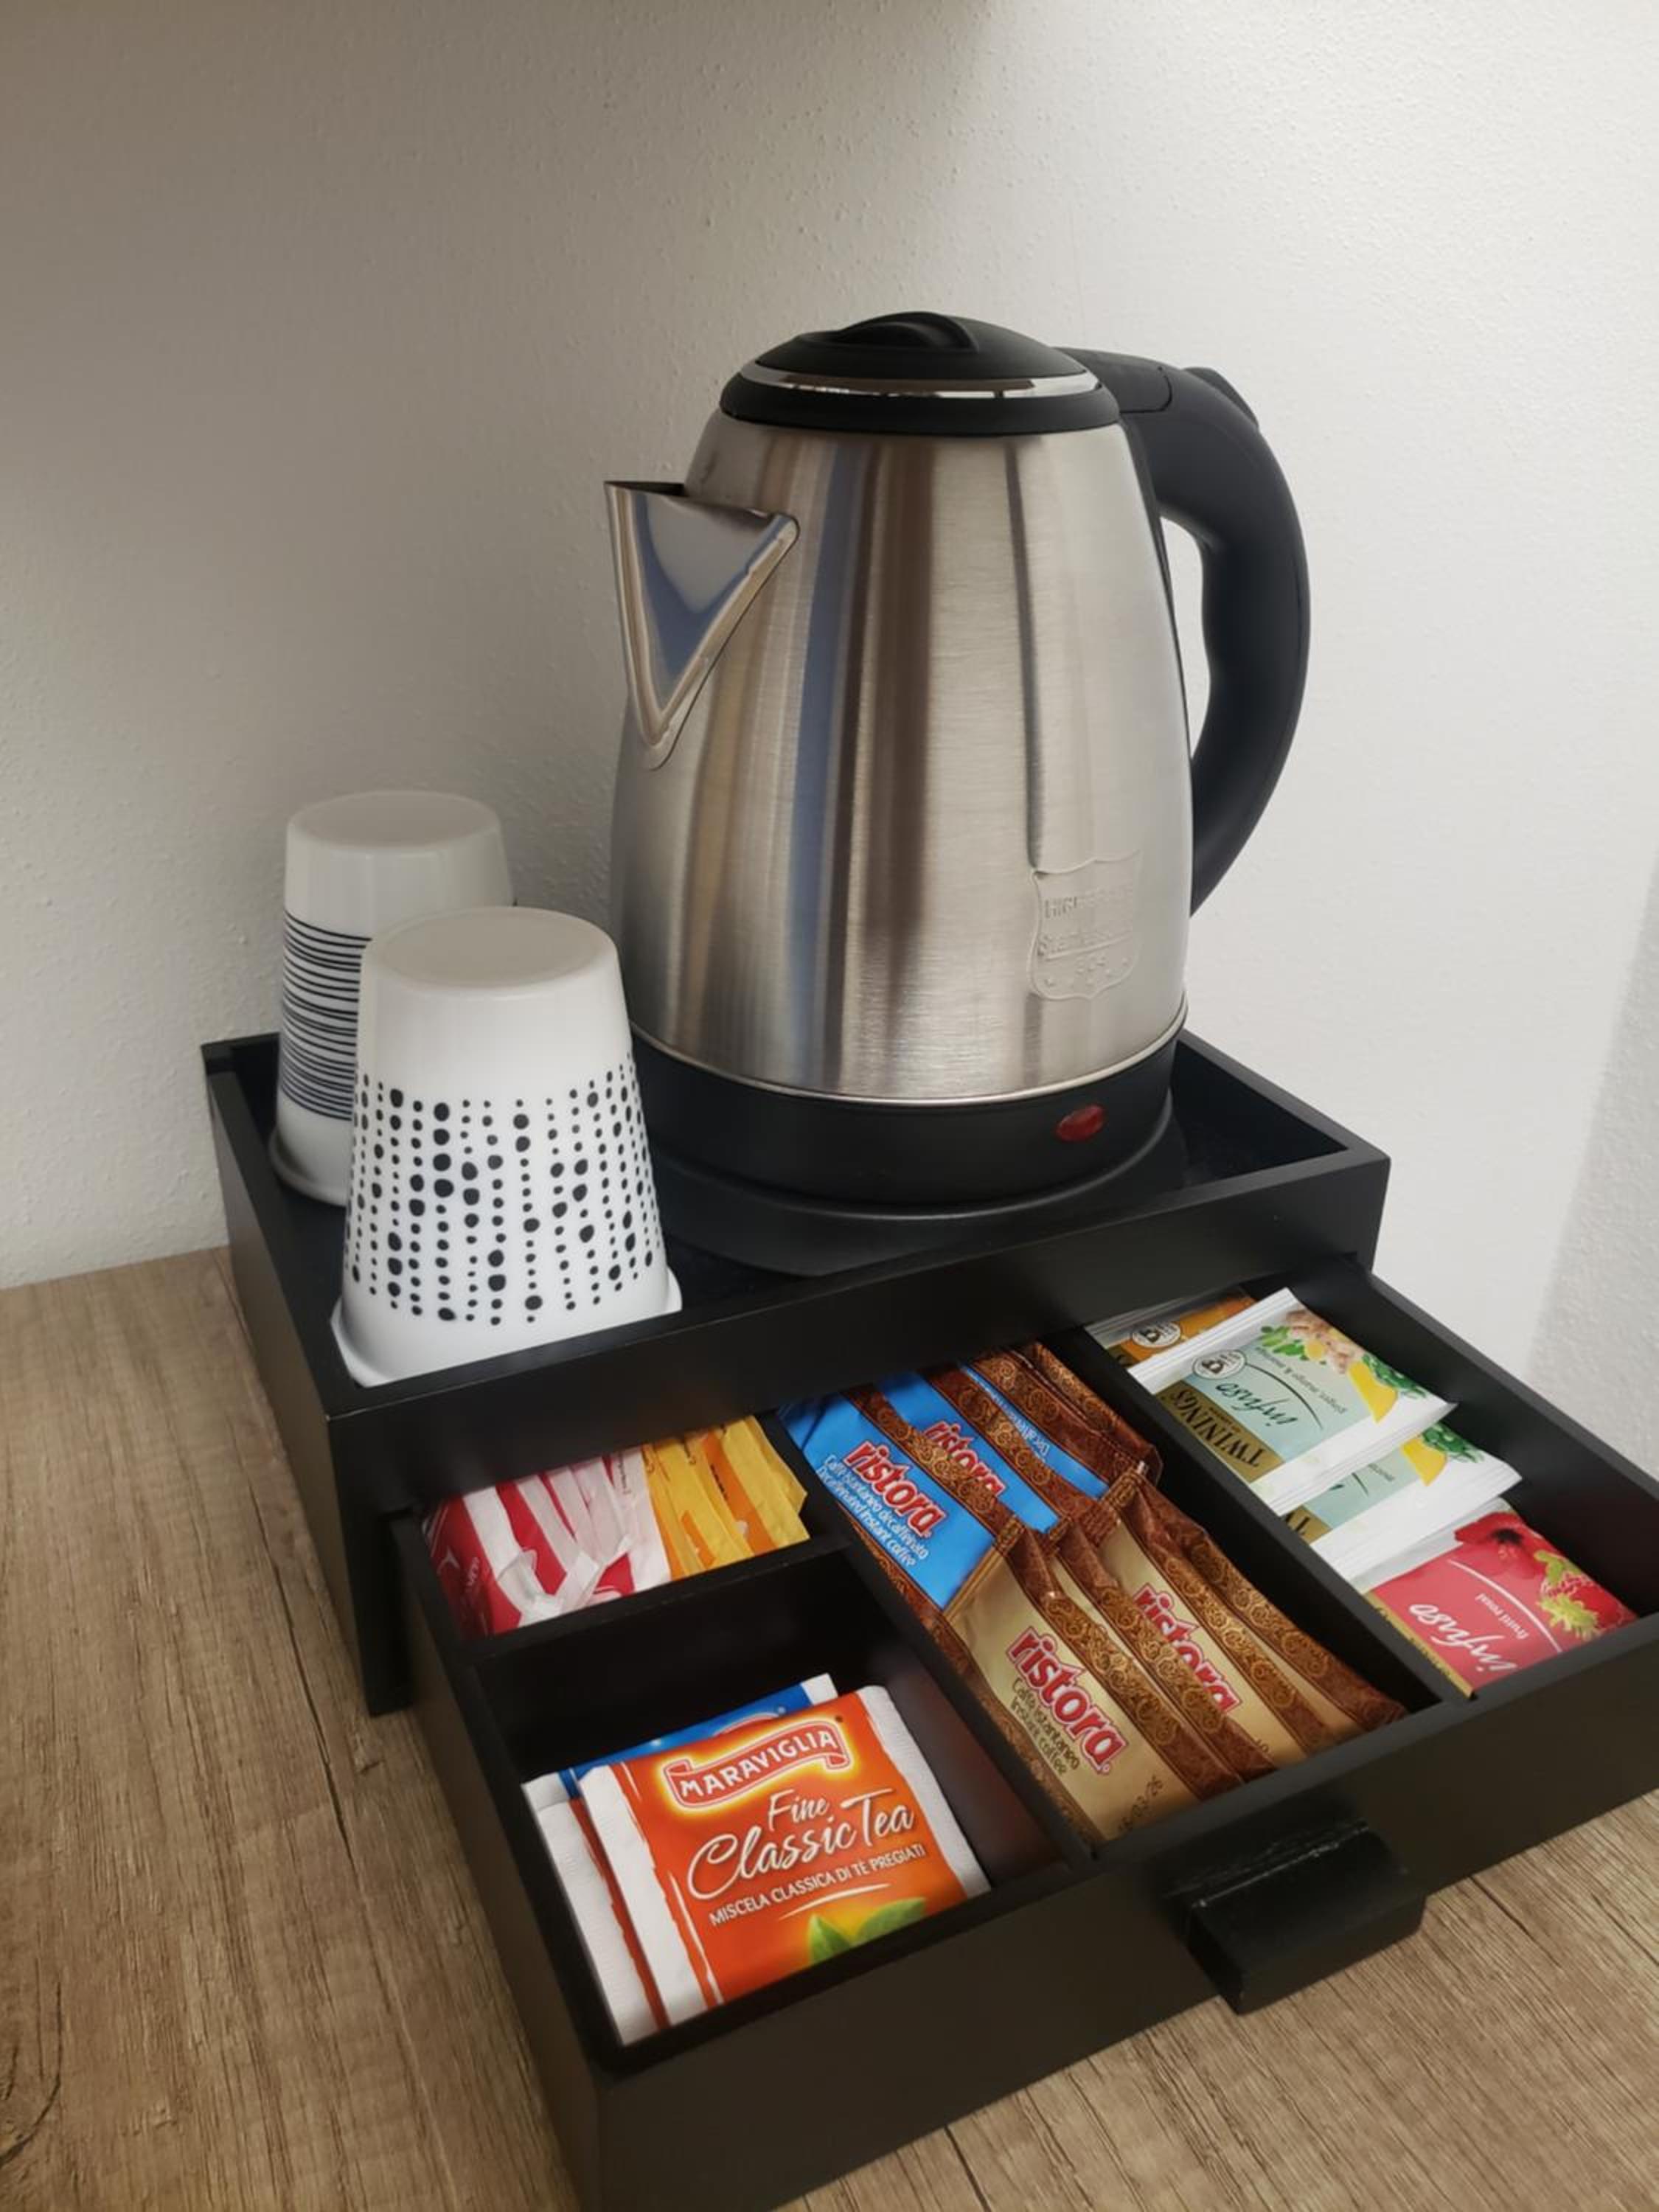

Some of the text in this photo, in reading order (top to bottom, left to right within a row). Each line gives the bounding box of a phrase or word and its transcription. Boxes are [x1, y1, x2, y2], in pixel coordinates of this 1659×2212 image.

[1169, 1388, 1266, 1469] TWININGS
[1217, 1382, 1298, 1427] infuso
[843, 1439, 947, 1538] ristora
[1409, 1602, 1518, 1672] infuso
[1007, 1627, 1130, 1774] ristora
[678, 1731, 838, 1799] MARAVIGLIA
[1032, 1708, 1082, 1770] istantaneo
[1037, 1736, 1068, 1775] coffee
[687, 1789, 915, 1900] Classic Tea
[768, 1789, 830, 1832] Fine
[709, 1896, 770, 1927] MISCELA
[771, 1873, 838, 1907] CLASSICA
[837, 1868, 851, 1886] DI
[867, 1844, 928, 1875] PREGIATI
